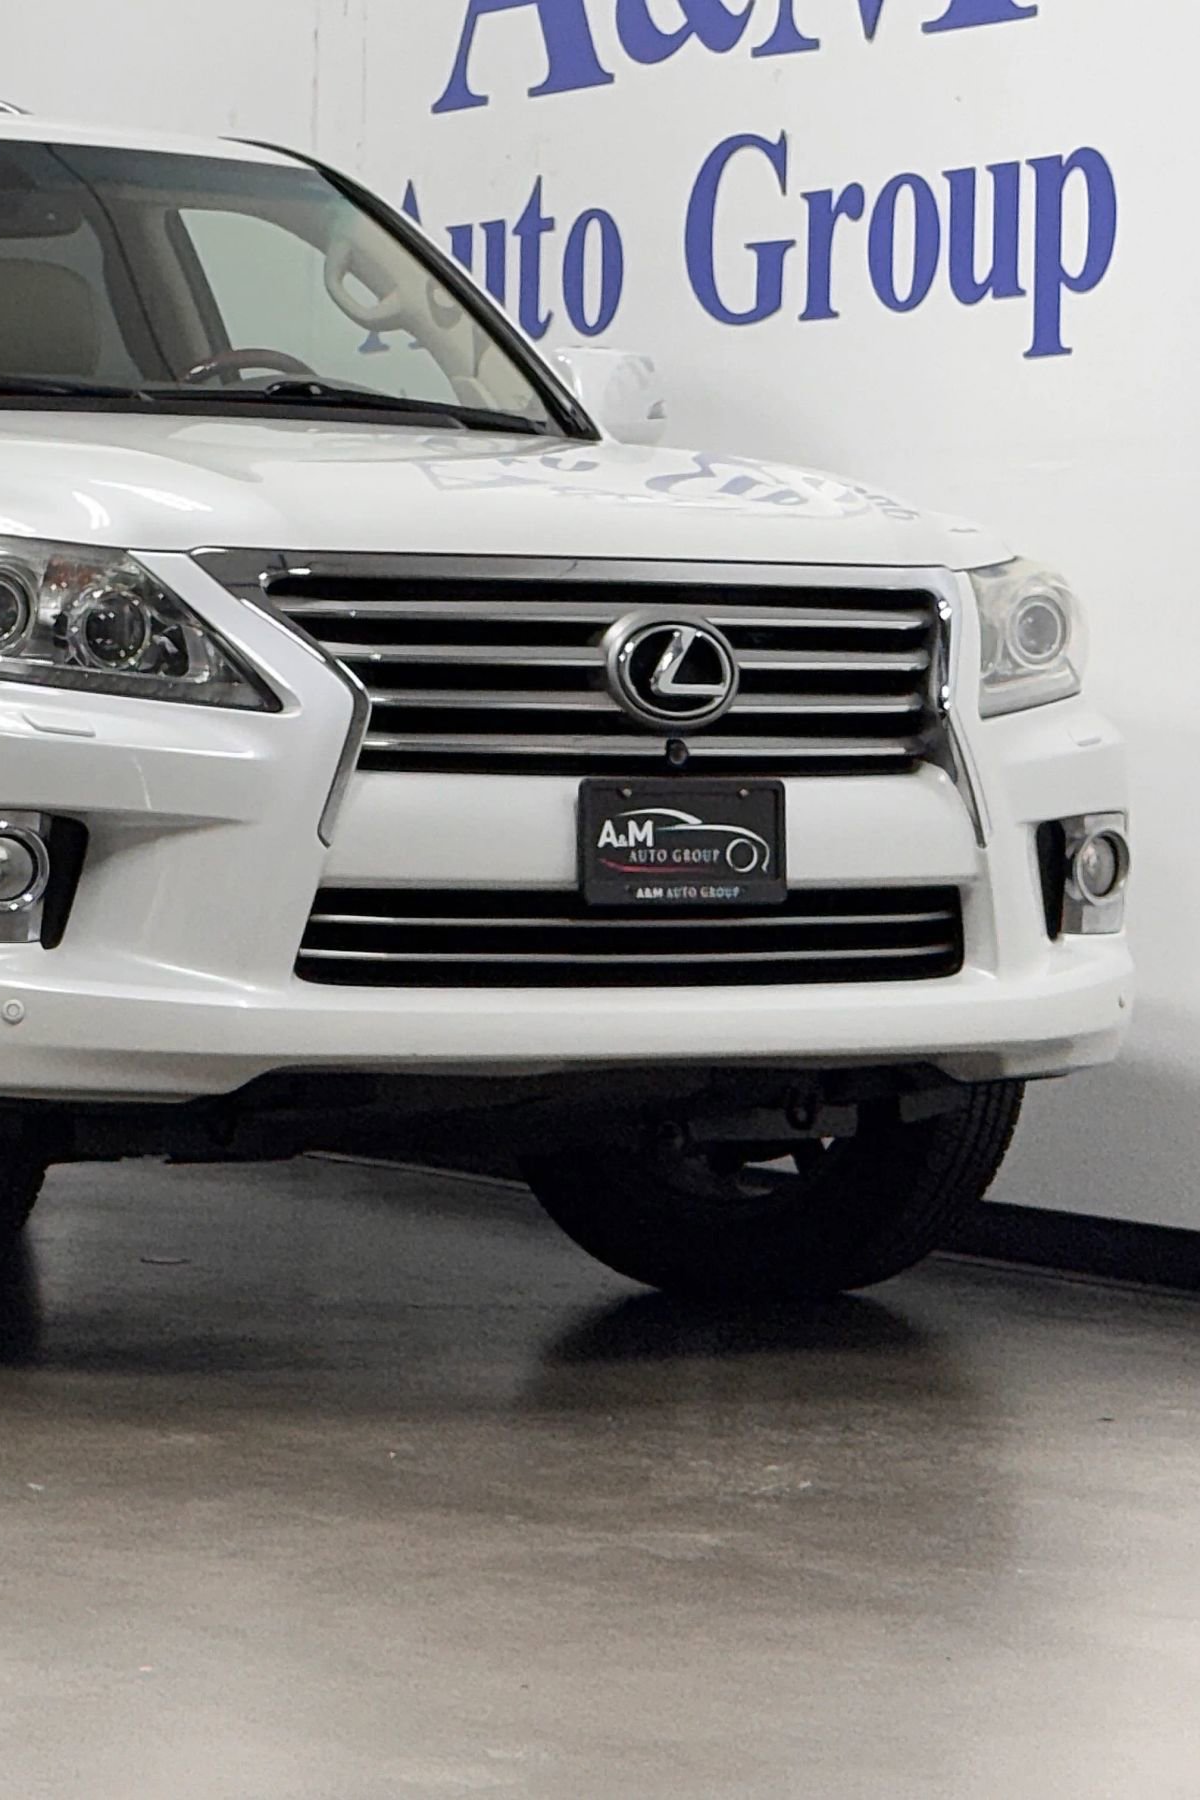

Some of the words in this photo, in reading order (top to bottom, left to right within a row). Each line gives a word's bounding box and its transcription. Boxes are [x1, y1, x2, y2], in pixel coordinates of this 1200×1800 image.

[684, 130, 1117, 359] Group
[597, 819, 654, 848] A&M
[628, 849, 668, 863] AUTO
[672, 849, 720, 863] GROUP
[636, 887, 663, 899] A&M
[666, 887, 697, 899] AUTO
[700, 886, 740, 898] GROUP
